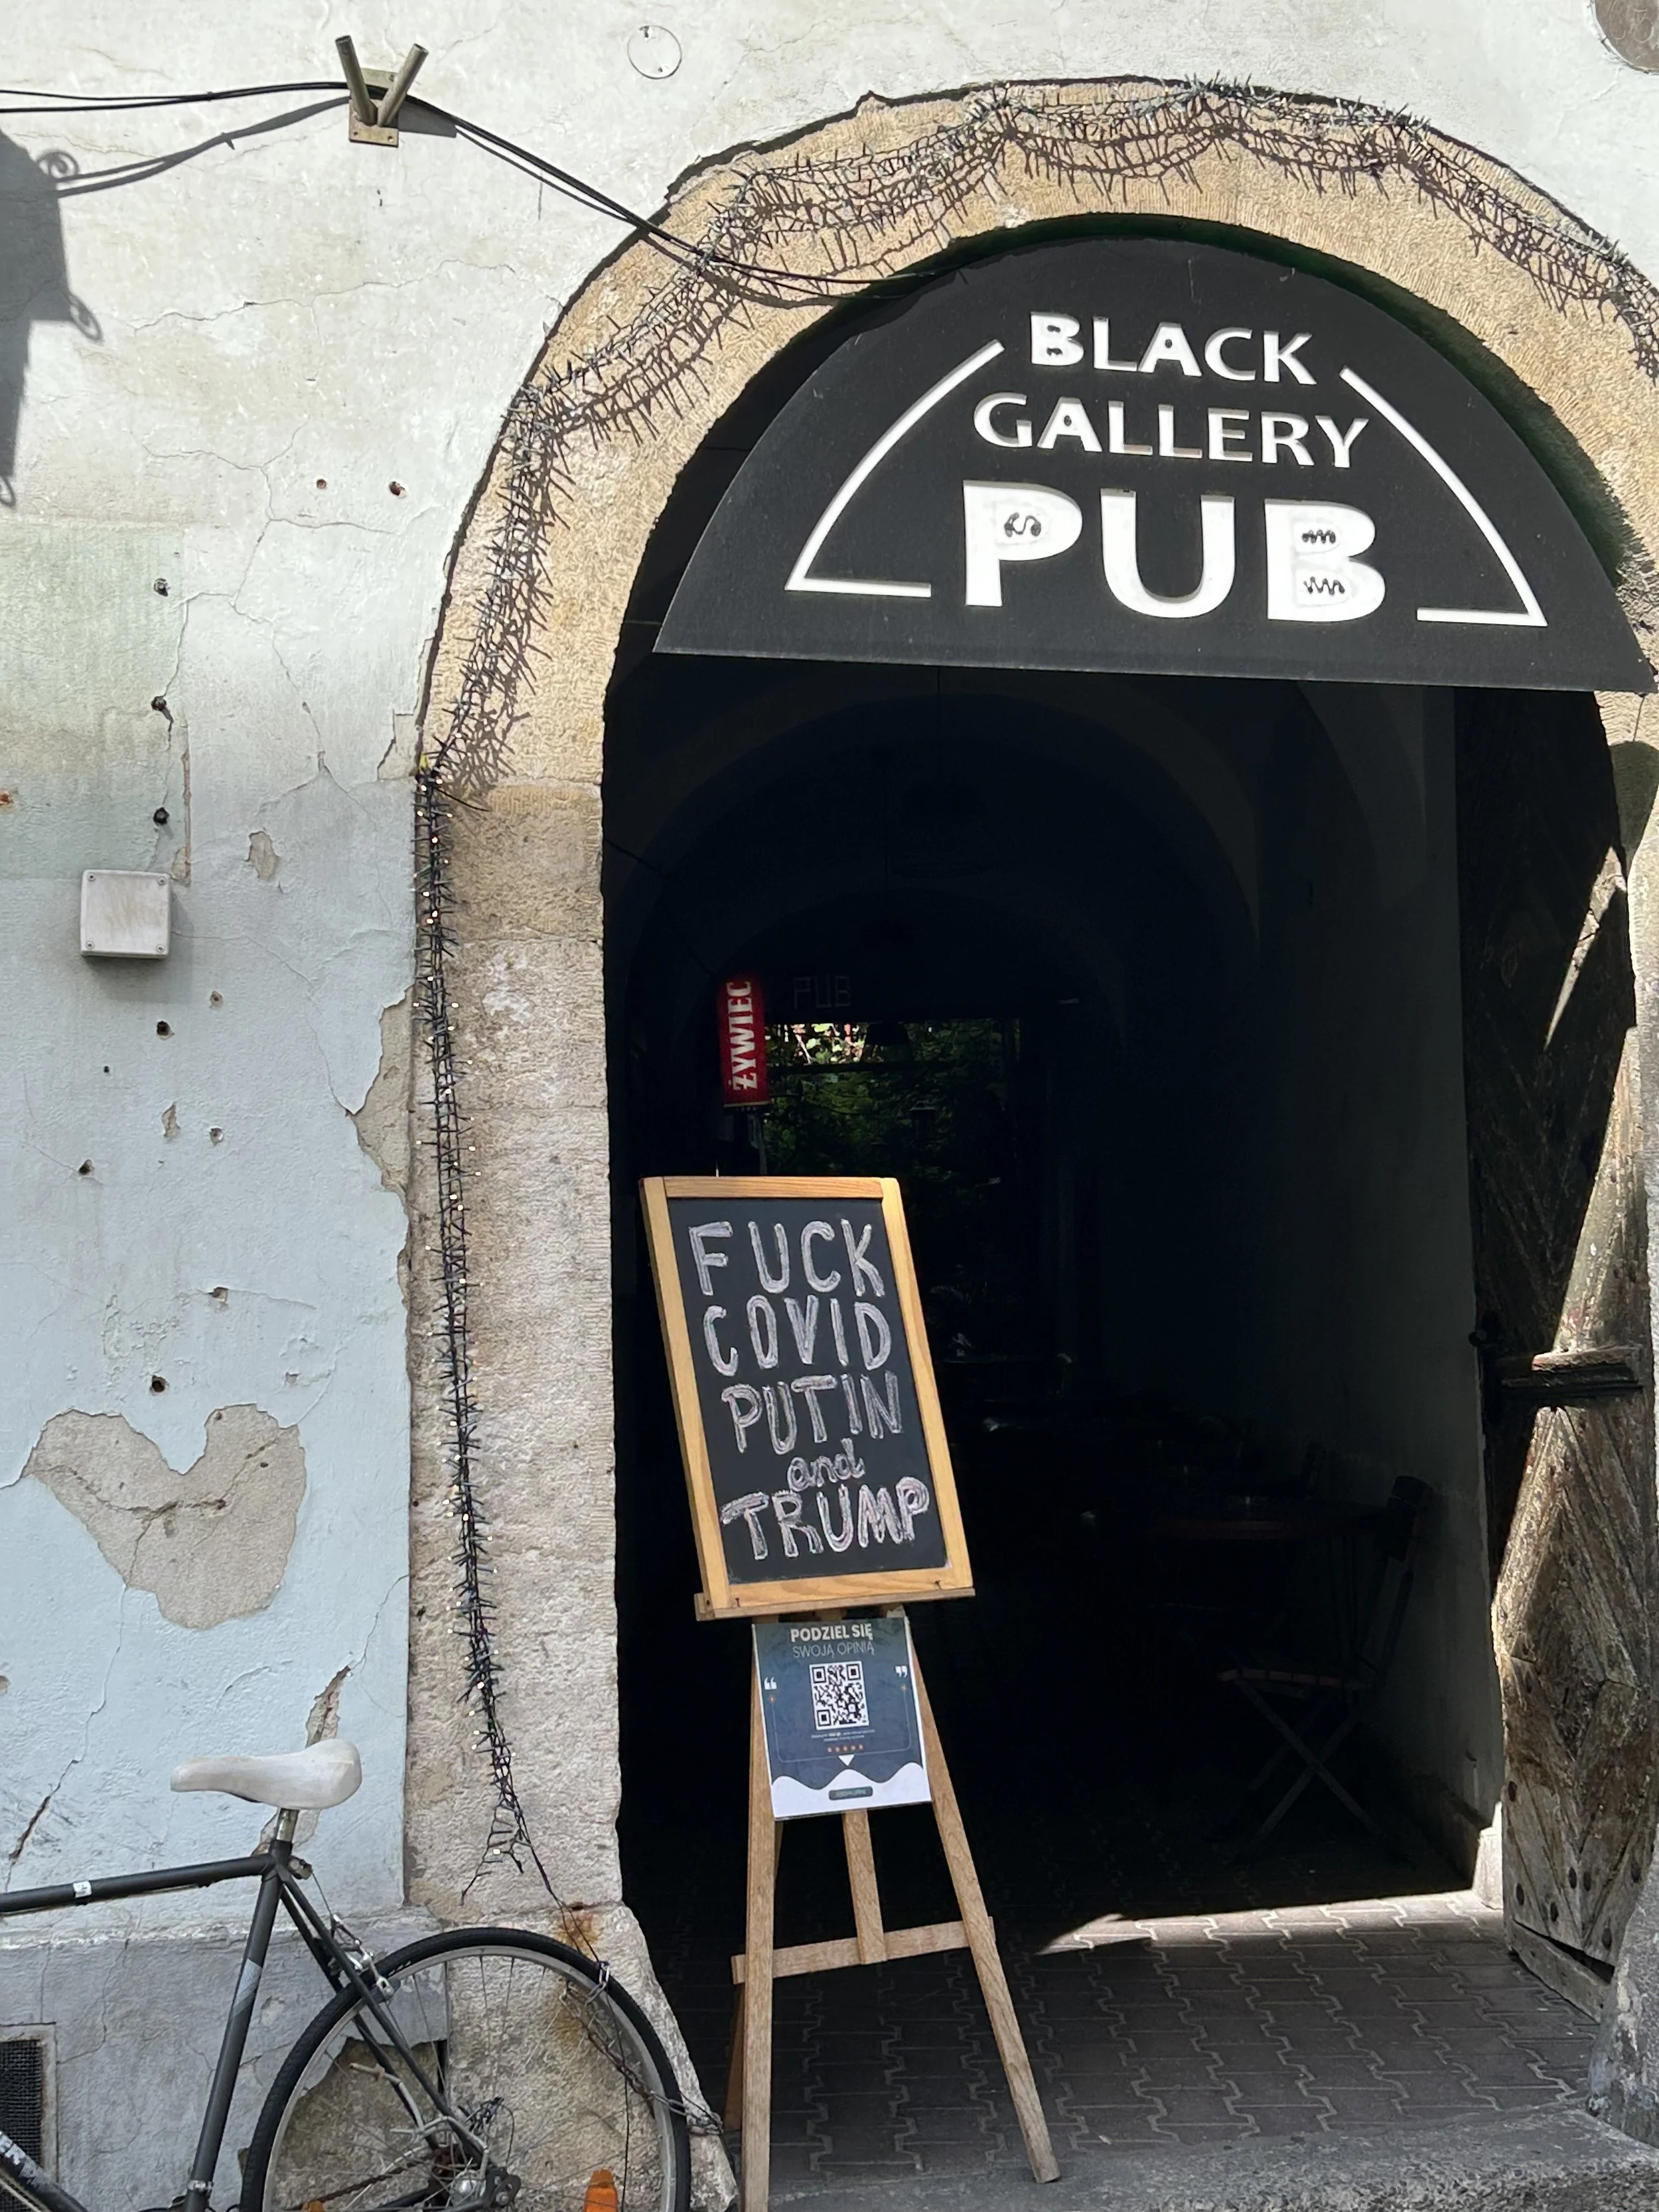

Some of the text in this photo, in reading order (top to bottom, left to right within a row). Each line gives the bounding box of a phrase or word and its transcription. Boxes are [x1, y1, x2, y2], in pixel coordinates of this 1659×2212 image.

[1030, 311, 1317, 385] BLACK
[974, 392, 1368, 468] GALLERY
[962, 480, 1386, 623] PUB
[793, 976, 851, 1009] PUB
[726, 981, 757, 1090] ŻYWIEC
[689, 1218, 885, 1296] FUCK
[703, 1295, 891, 1376] COVID
[721, 1369, 904, 1455] PUTIN
[787, 1438, 865, 1491] and
[720, 1477, 930, 1560] TRUMP
[790, 1623, 873, 1643] PODZIEL SIĘ
[792, 1641, 875, 1659] SWOJĄ OPINIĄ
